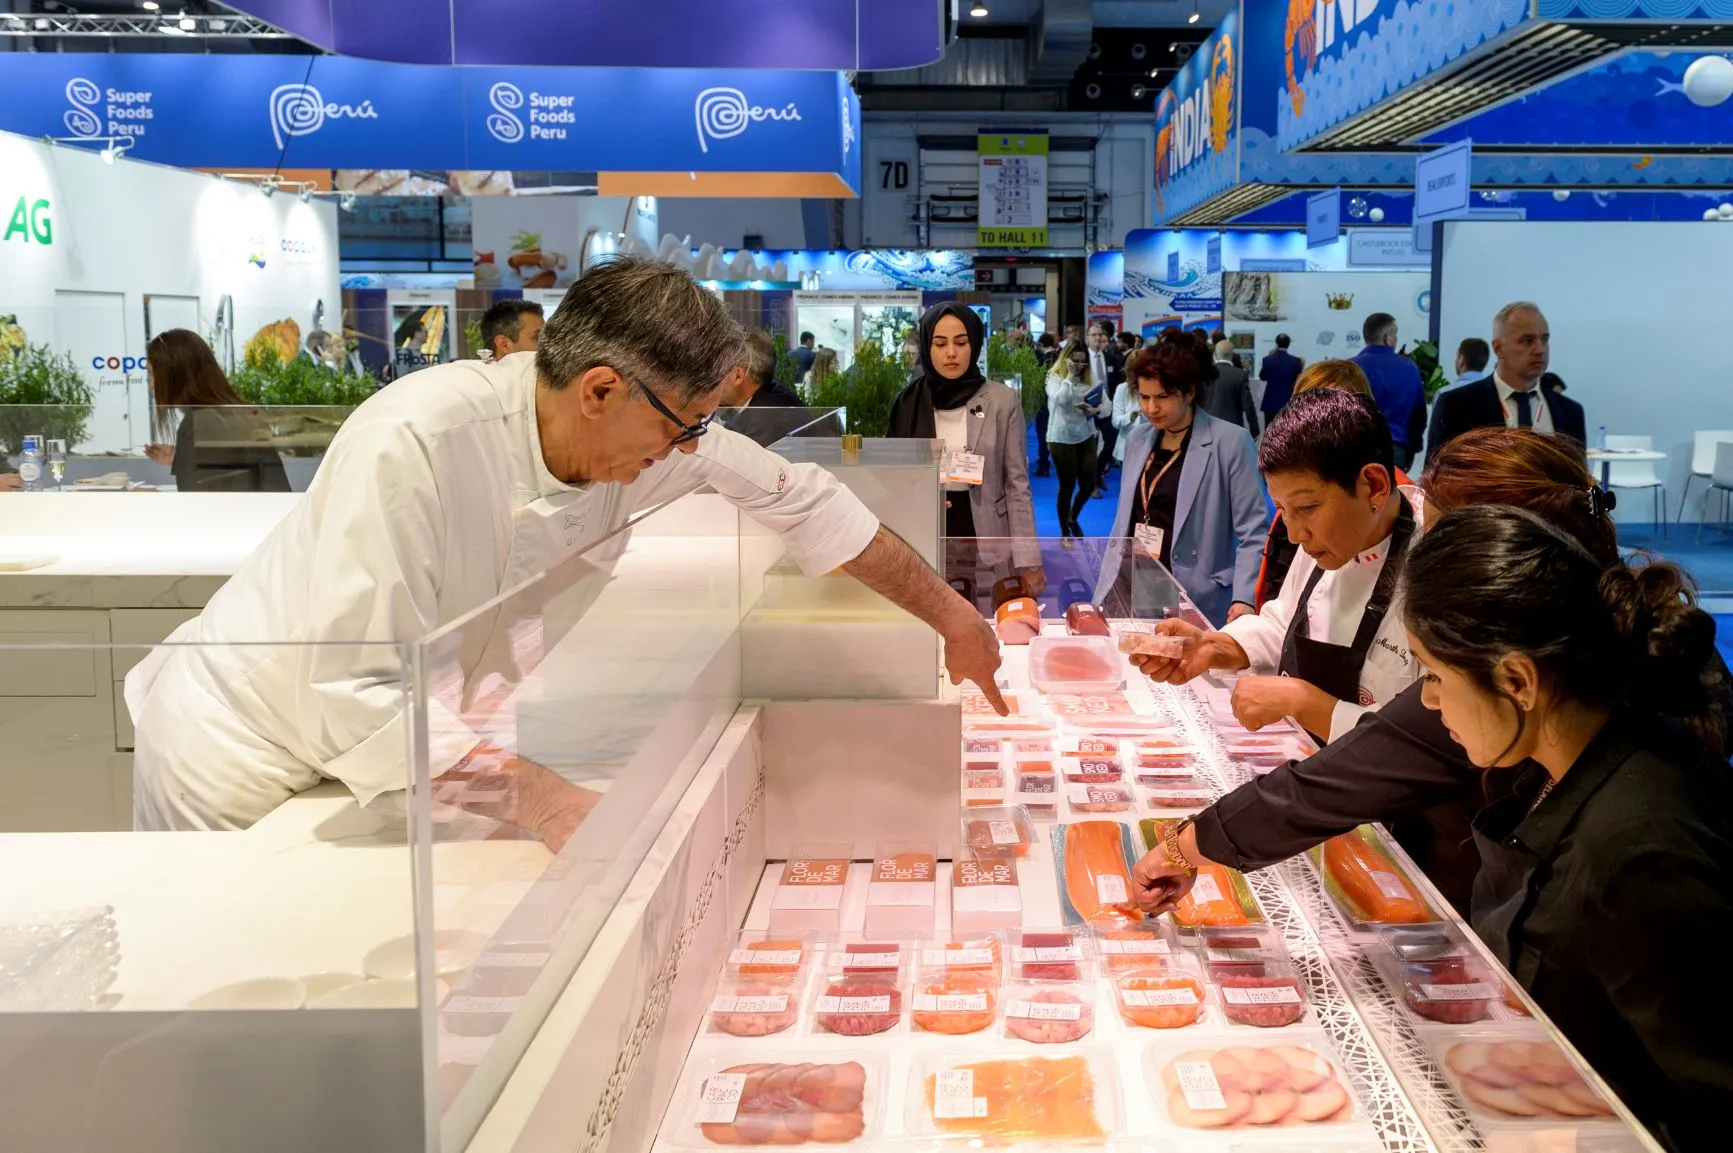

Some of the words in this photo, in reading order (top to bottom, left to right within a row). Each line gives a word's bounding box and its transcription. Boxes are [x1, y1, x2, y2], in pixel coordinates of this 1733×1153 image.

[106, 88, 152, 105] Super
[529, 92, 574, 109] Super
[107, 105, 154, 119] Foods
[269, 83, 378, 150] Perú
[530, 109, 576, 123] Foods
[695, 87, 801, 153] Perú
[108, 121, 145, 135] Peru
[530, 125, 567, 139] Peru
[1169, 78, 1212, 176] INDIA
[880, 160, 908, 189] 7D
[3, 196, 52, 245] AG
[981, 232, 995, 243] TO
[999, 232, 1026, 243] HALL
[1032, 232, 1044, 243] 11
[789, 862, 810, 883] FLOR
[805, 871, 823, 883] DE
[823, 864, 842, 883] MAR
[880, 859, 897, 879] FLOR
[896, 868, 912, 879] DE
[912, 862, 929, 879] MAR
[961, 862, 978, 884] FLOR
[978, 871, 994, 883] DE
[994, 864, 1011, 883] MAR
